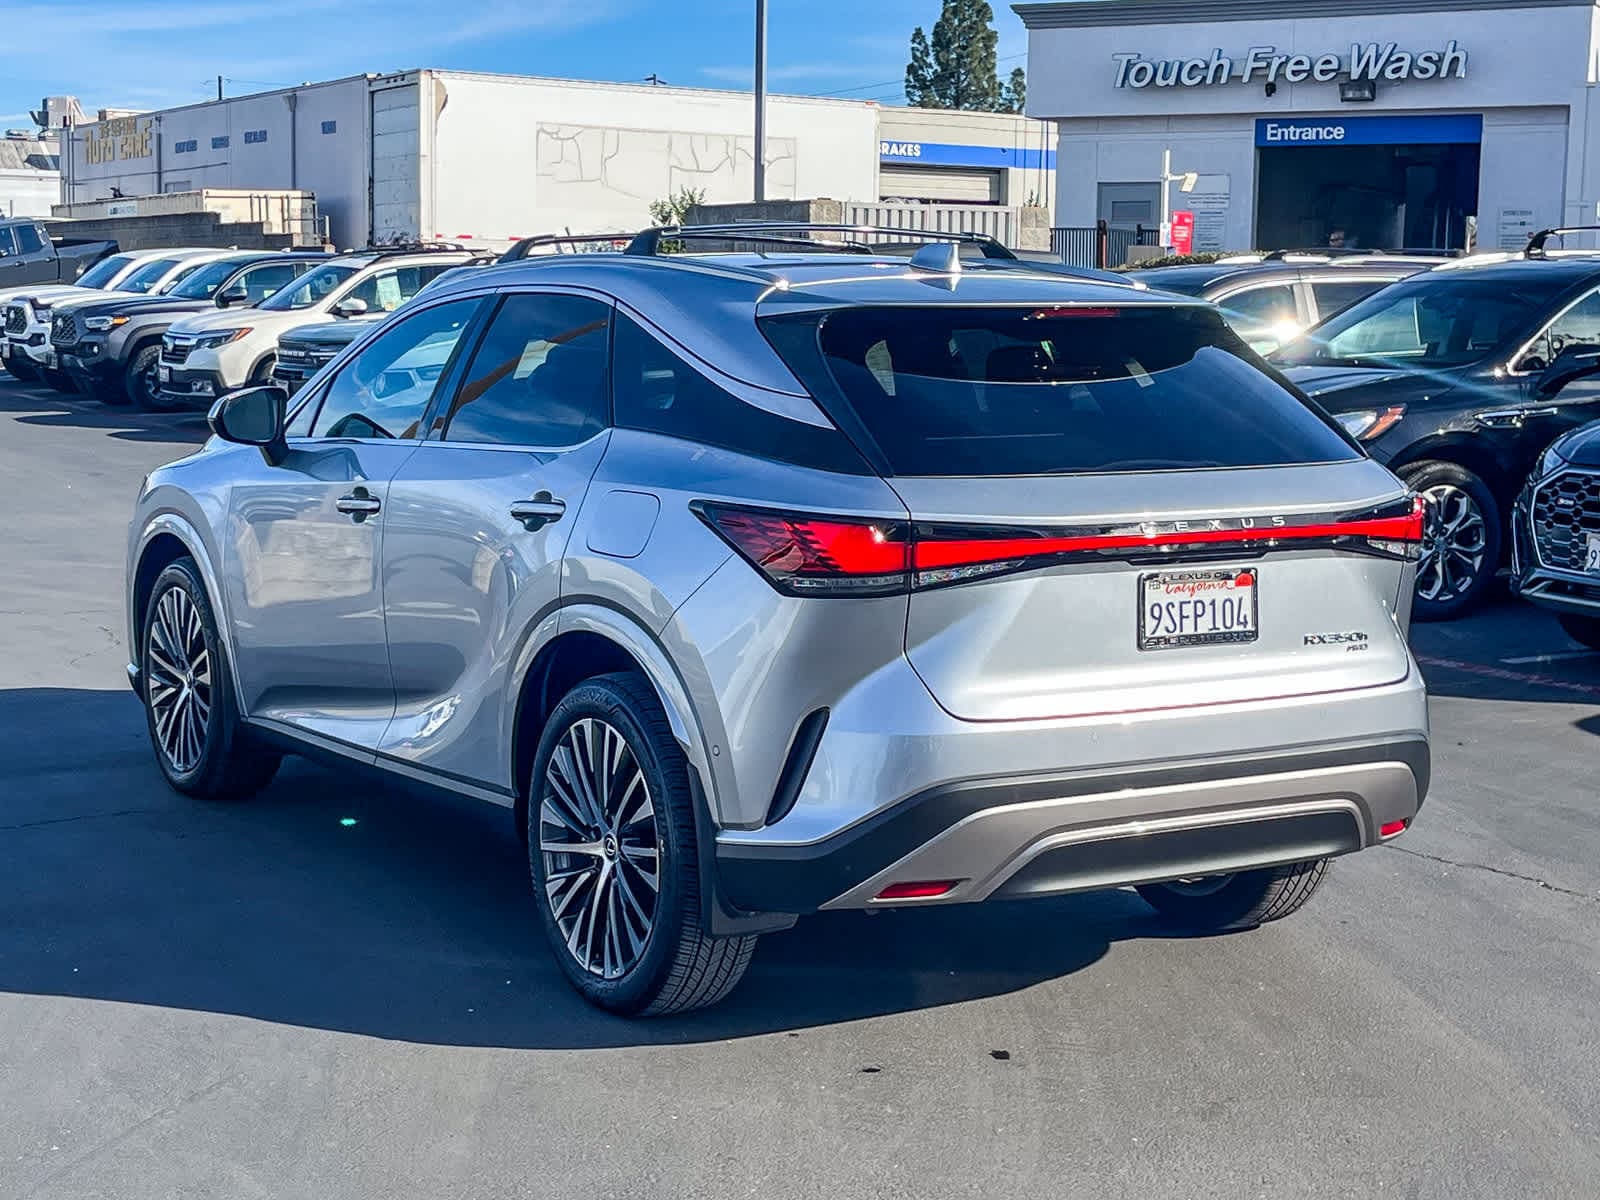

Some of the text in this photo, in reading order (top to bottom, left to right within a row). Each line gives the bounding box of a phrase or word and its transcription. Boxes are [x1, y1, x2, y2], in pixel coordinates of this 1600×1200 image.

[1112, 39, 1468, 88] Touch Free Wash
[1265, 123, 1345, 141] Entrance
[1139, 516, 1286, 534] LEXUS
[1149, 596, 1249, 636] 9SFP104
